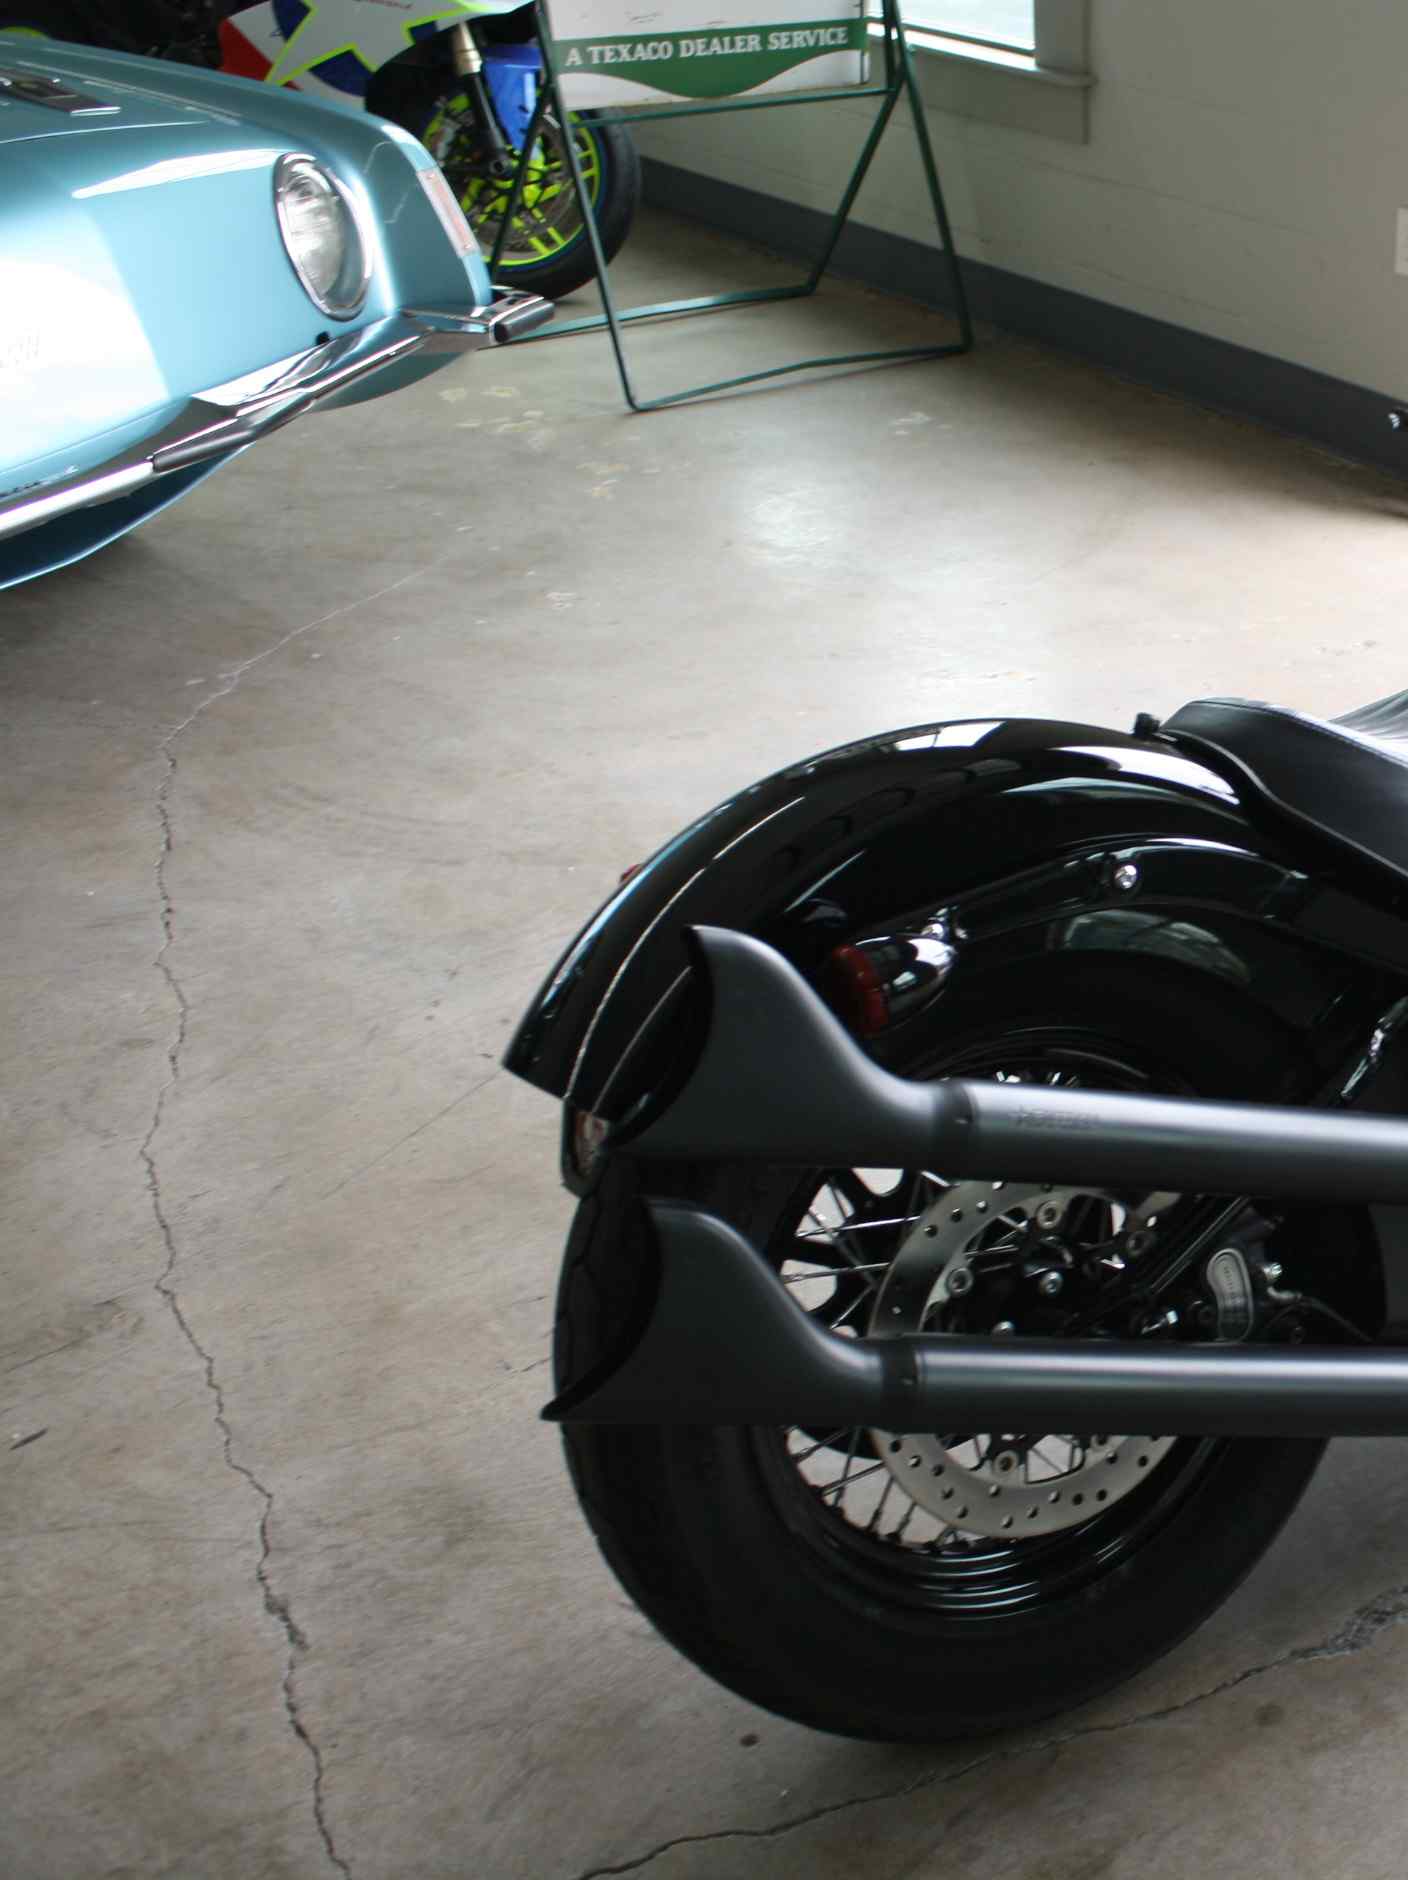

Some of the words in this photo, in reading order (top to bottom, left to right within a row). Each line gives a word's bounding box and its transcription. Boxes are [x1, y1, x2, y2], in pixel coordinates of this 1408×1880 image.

[564, 47, 583, 66] A
[586, 41, 674, 64] TEXACO
[678, 34, 762, 57] DEALER
[767, 27, 848, 50] SERVICE
